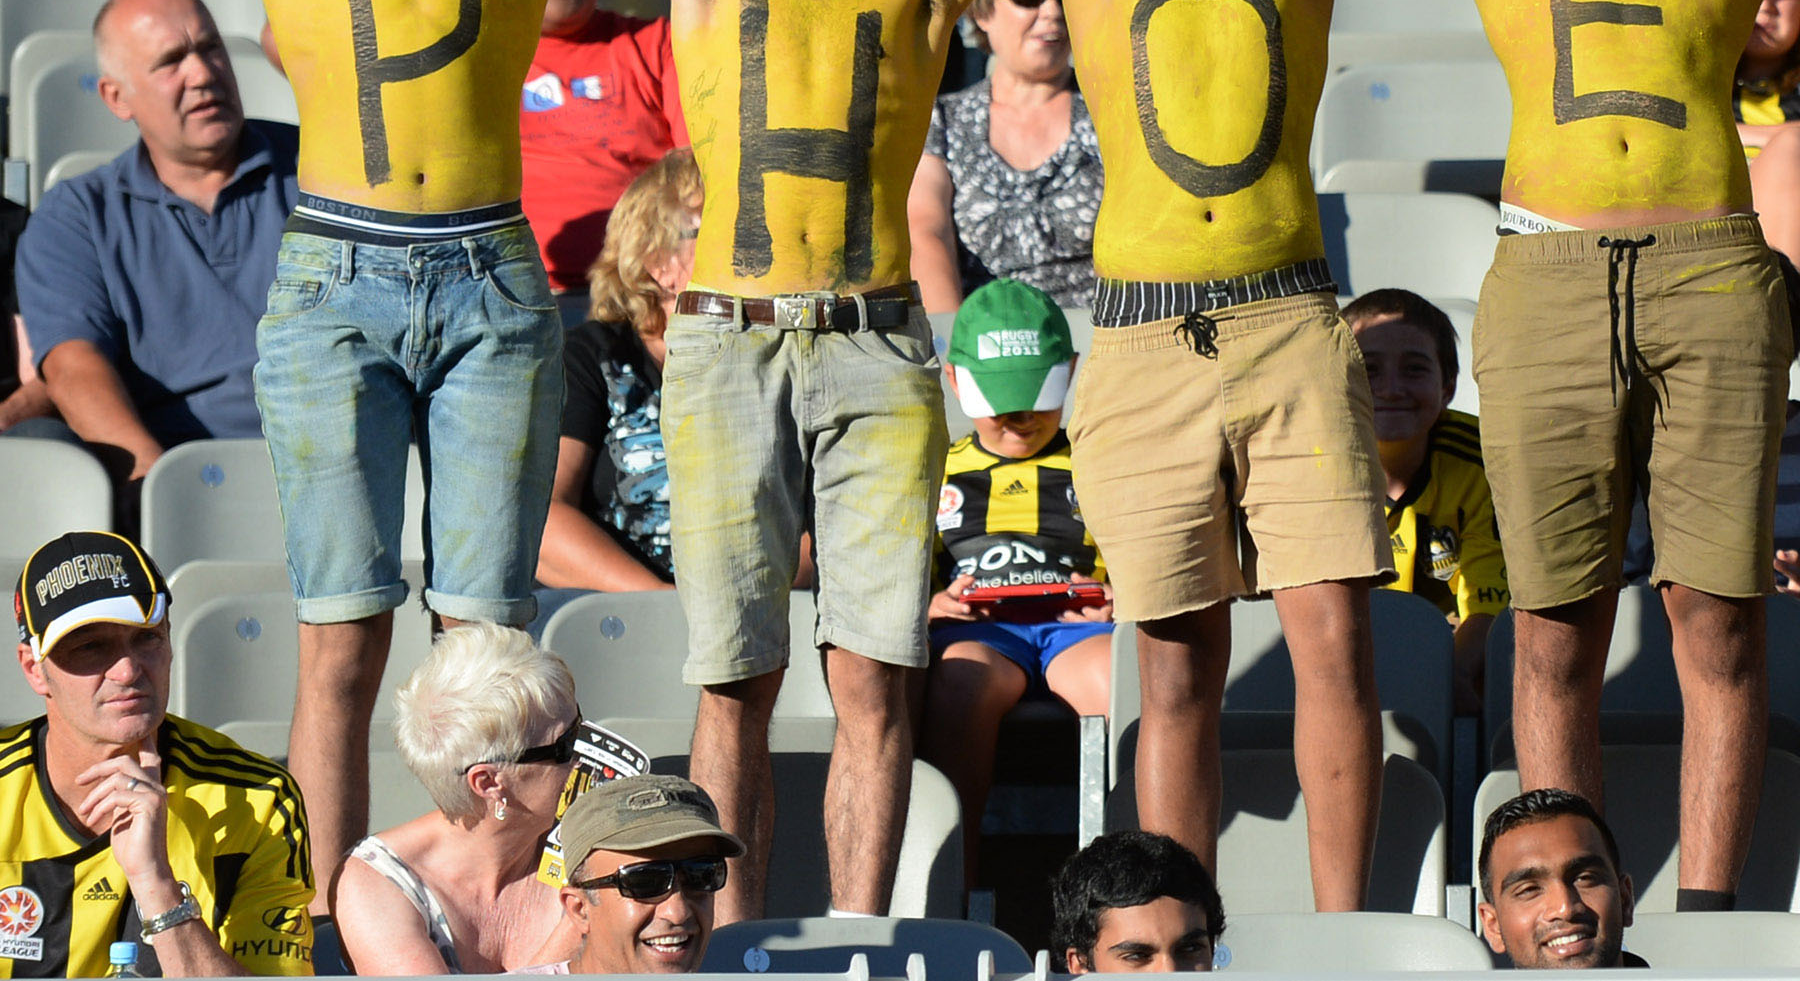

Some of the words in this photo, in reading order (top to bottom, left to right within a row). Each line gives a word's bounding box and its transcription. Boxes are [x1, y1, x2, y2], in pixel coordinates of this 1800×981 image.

[307, 196, 377, 221] BOSTON
[1002, 329, 1038, 340] RUGBY
[1002, 346, 1041, 356] 2011
[36, 553, 127, 607] PHOENIX
[111, 576, 131, 589] FC
[82, 892, 120, 901] adidas
